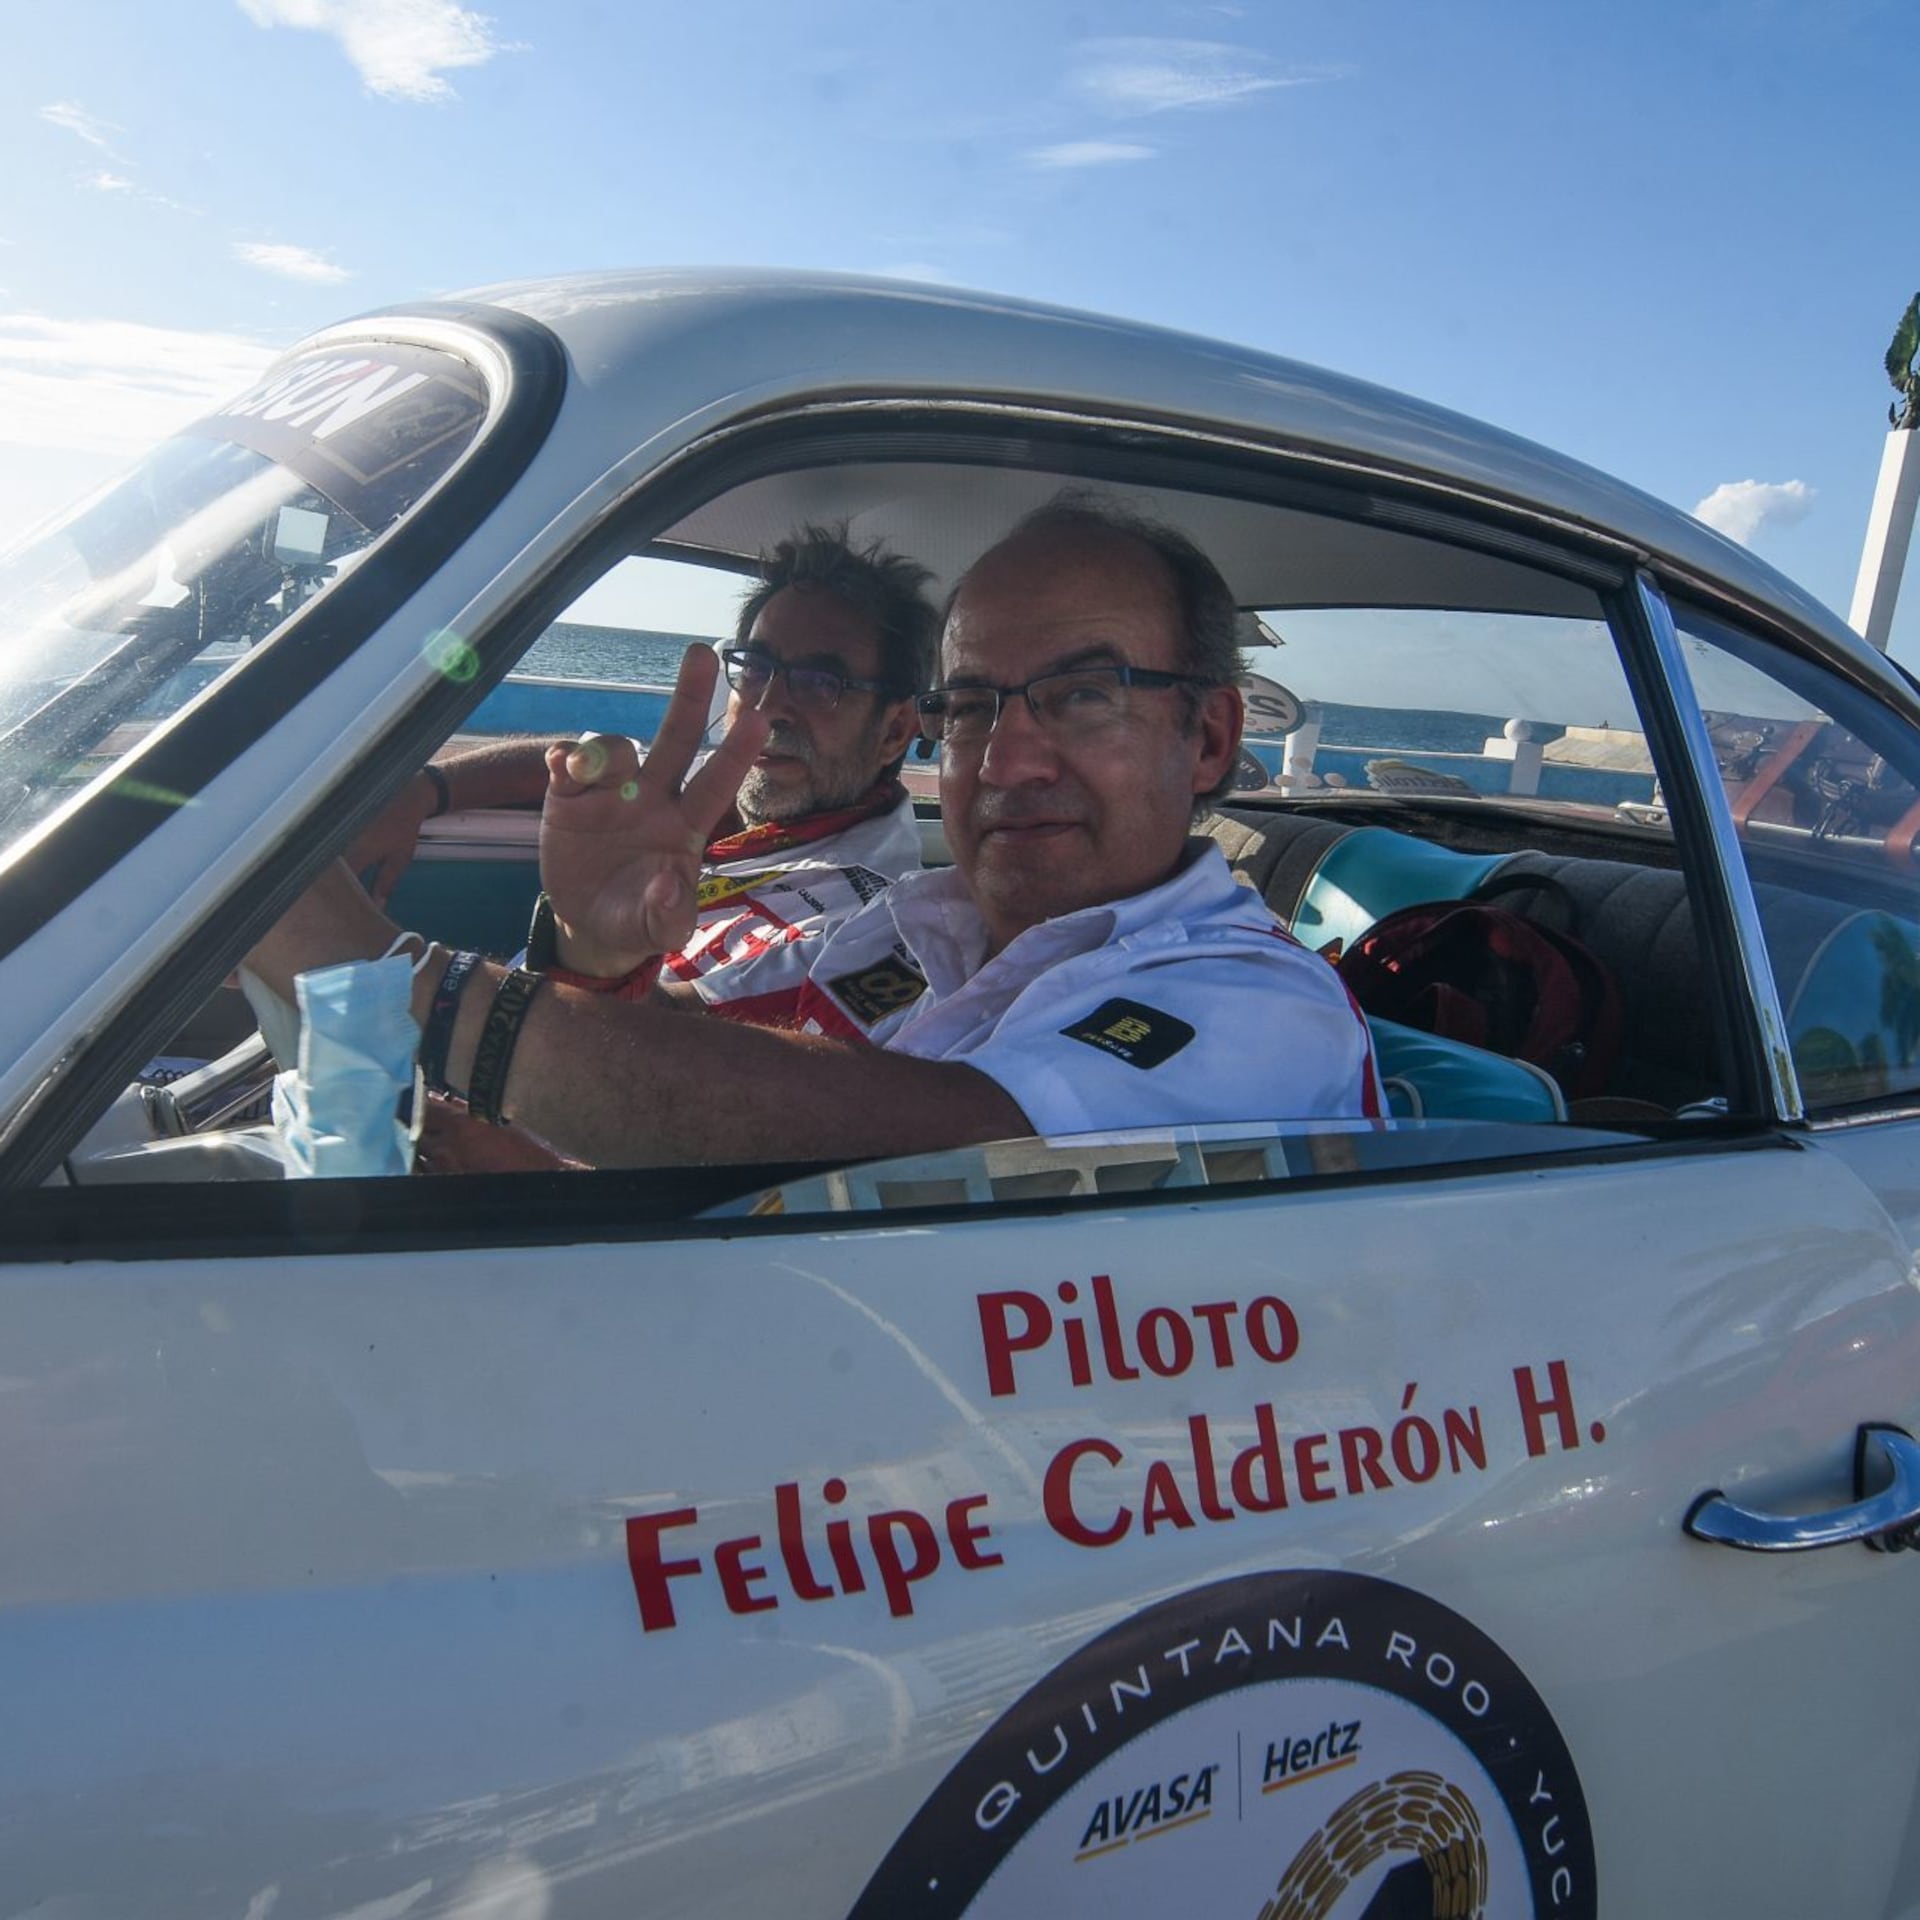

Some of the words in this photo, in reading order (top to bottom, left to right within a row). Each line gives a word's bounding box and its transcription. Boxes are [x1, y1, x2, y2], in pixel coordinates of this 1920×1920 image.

[1513, 1360, 1606, 1457] H.
[975, 1616, 1350, 1831] QUINTANA
[1385, 1630, 1490, 1717] ROO
[1262, 1719, 1362, 1783] Hertz
[1079, 1764, 1216, 1850] AVASA
